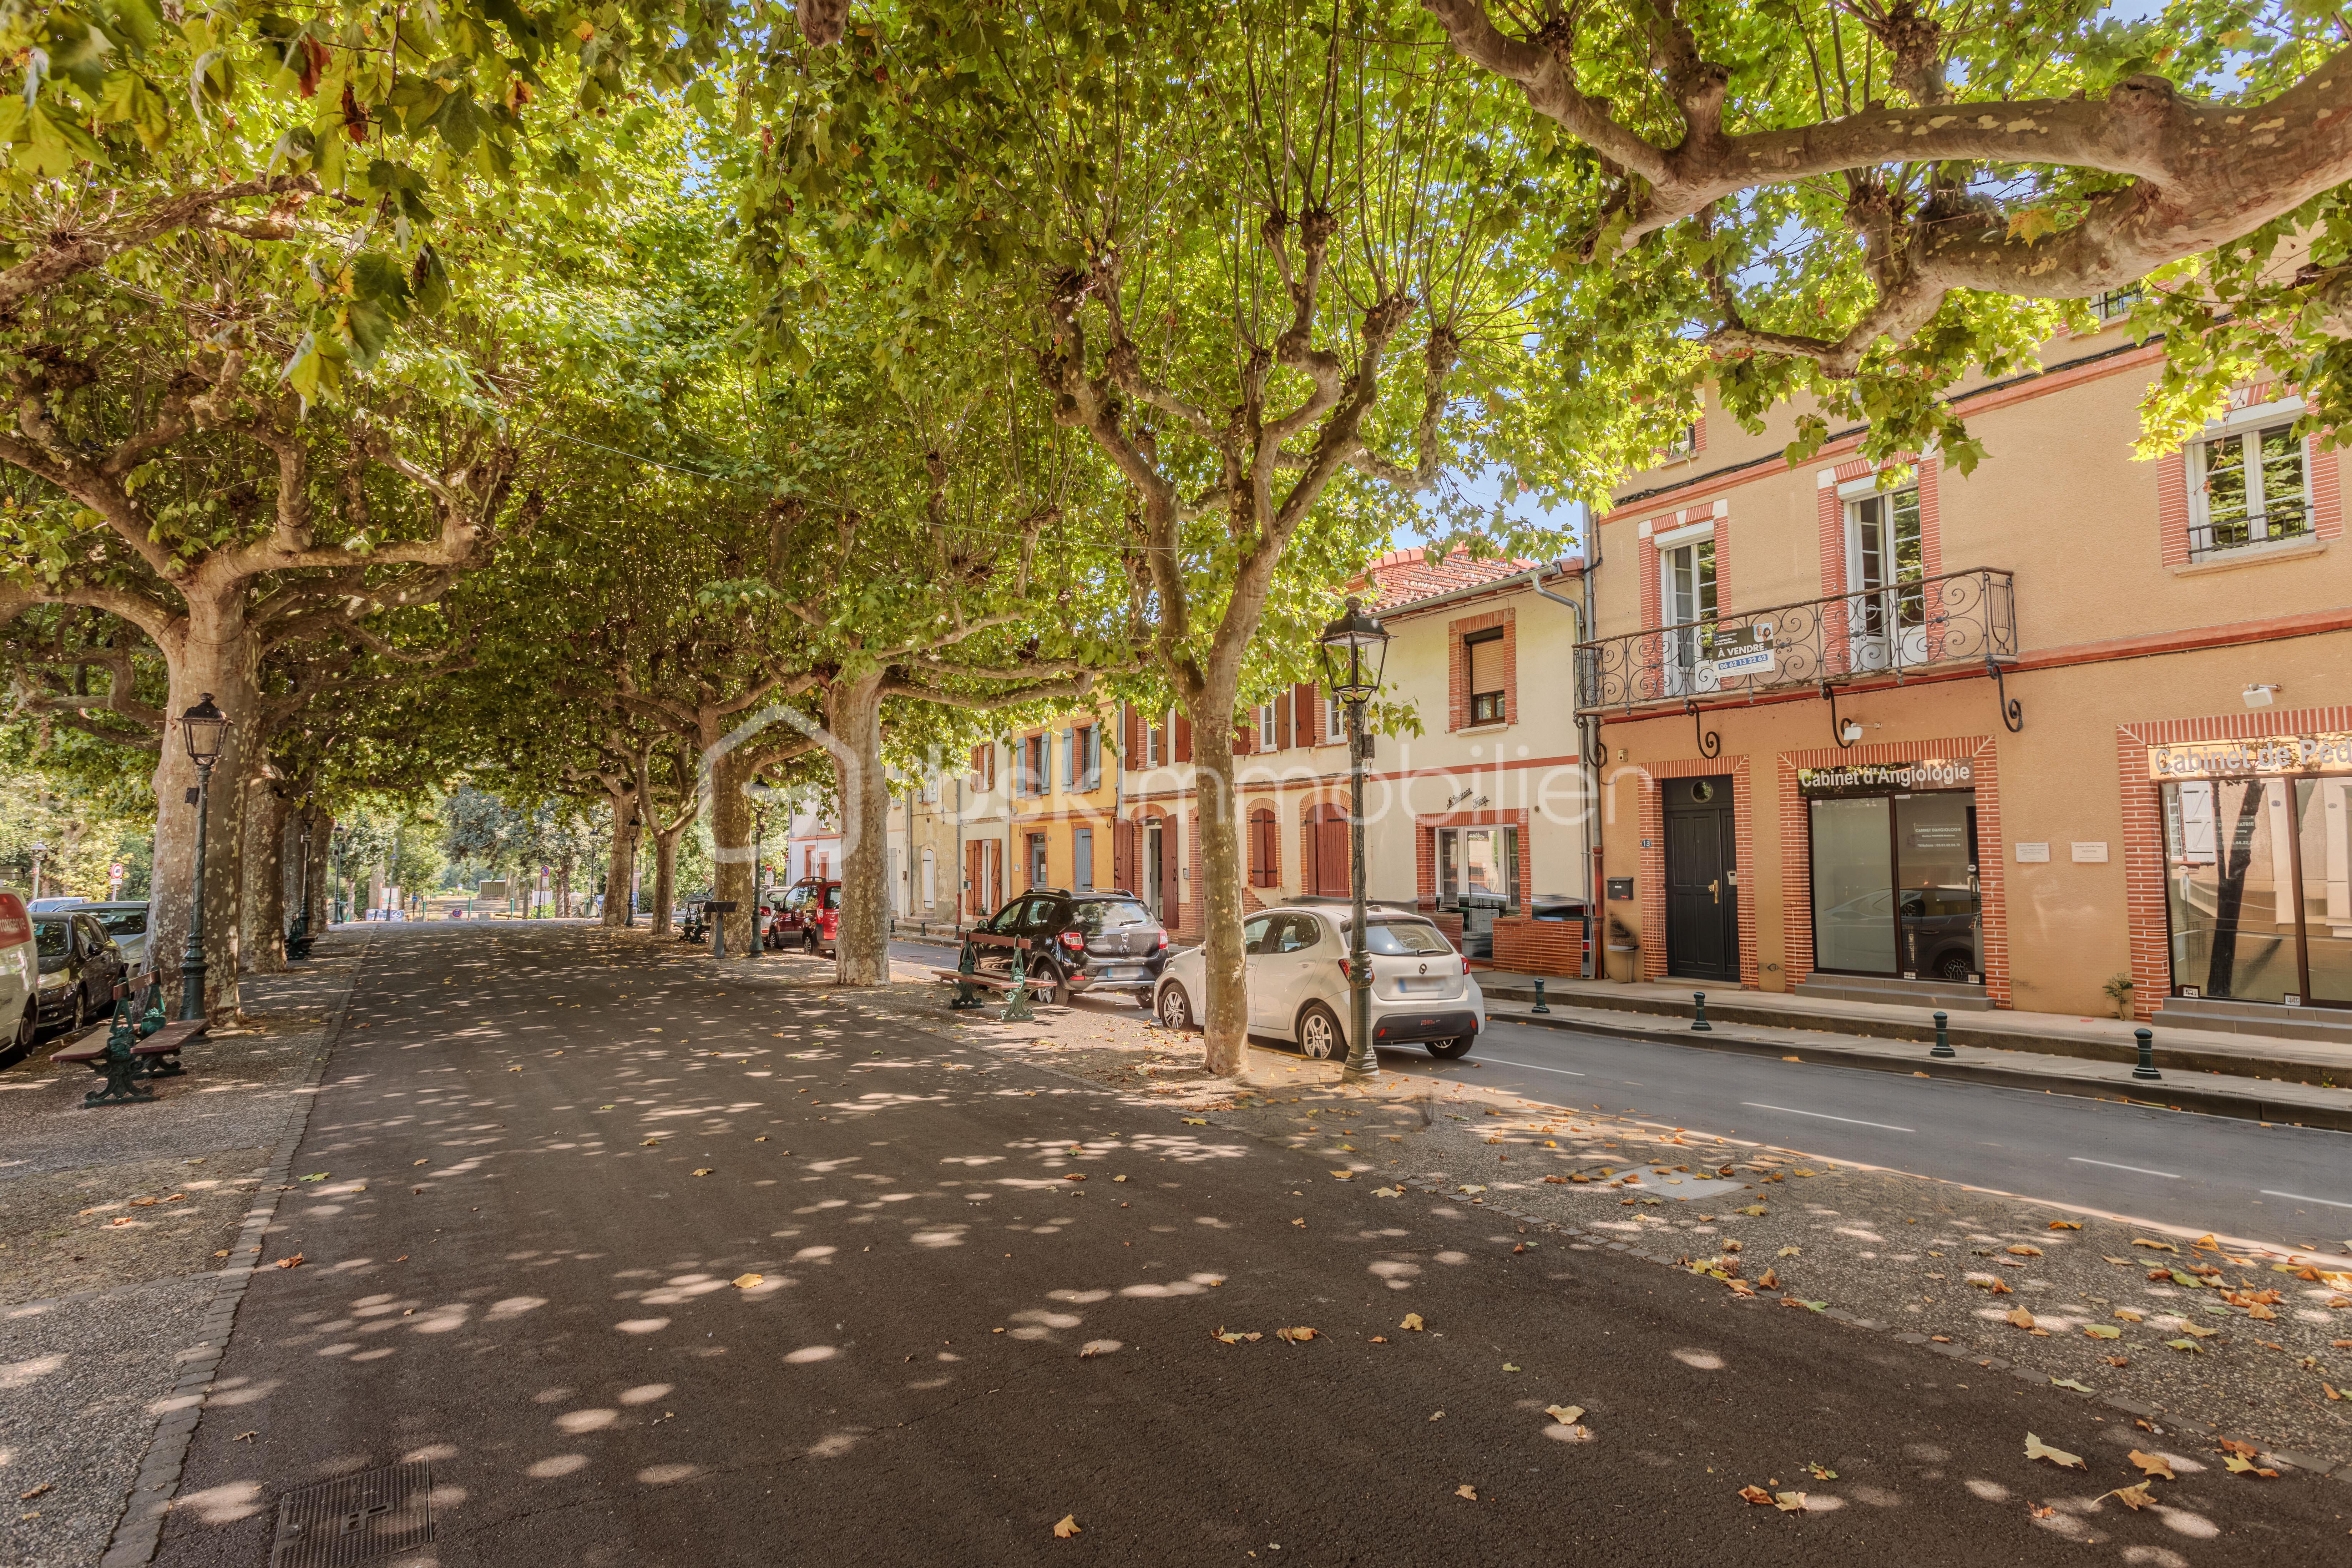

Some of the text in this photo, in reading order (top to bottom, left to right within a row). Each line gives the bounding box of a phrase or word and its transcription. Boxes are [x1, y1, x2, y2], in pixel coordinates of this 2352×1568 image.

[1718, 648, 1725, 658] À
[2155, 745, 2251, 773] Cabinet
[2259, 741, 2290, 767] de
[1801, 763, 1970, 787] Cabinet d'Angiologie
[1473, 796, 1490, 810] Forge
